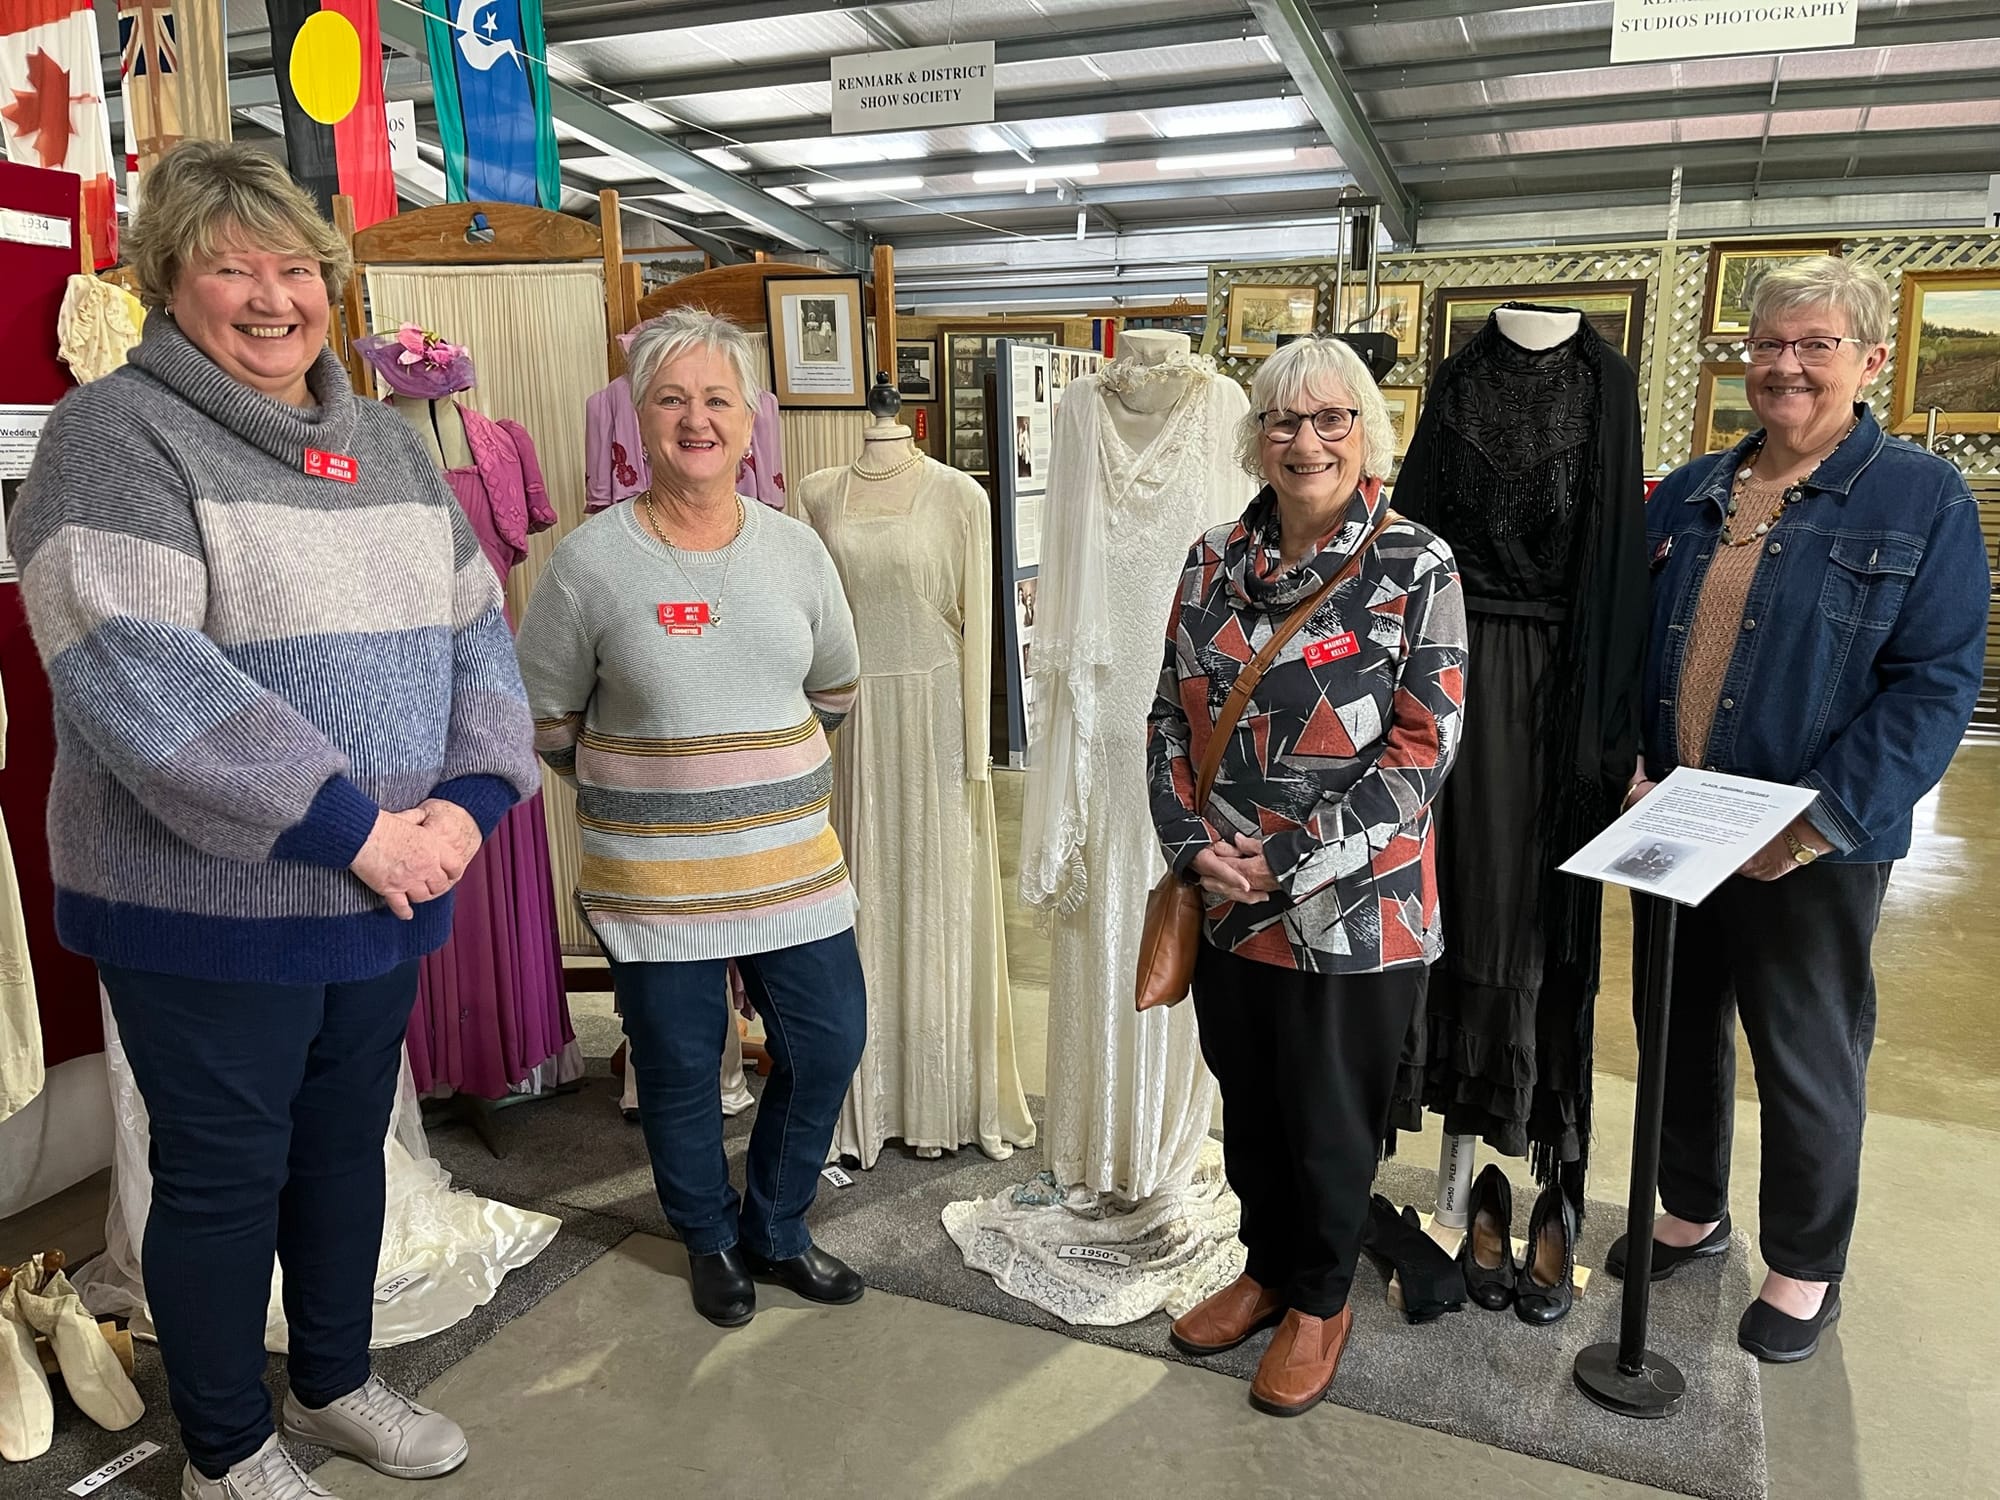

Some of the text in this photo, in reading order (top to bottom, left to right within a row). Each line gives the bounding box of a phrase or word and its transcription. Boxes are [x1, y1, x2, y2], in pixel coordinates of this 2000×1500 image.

[1620, 1, 1849, 32] STUDIOS PHOTOGRAPHY
[838, 65, 987, 91] RENMARK & DISTRICT
[860, 89, 962, 109] SHOW SOCIETY
[0, 429, 38, 438] Wedding
[1080, 1249, 1119, 1261] 1950's
[84, 1449, 147, 1487] C 1920's
